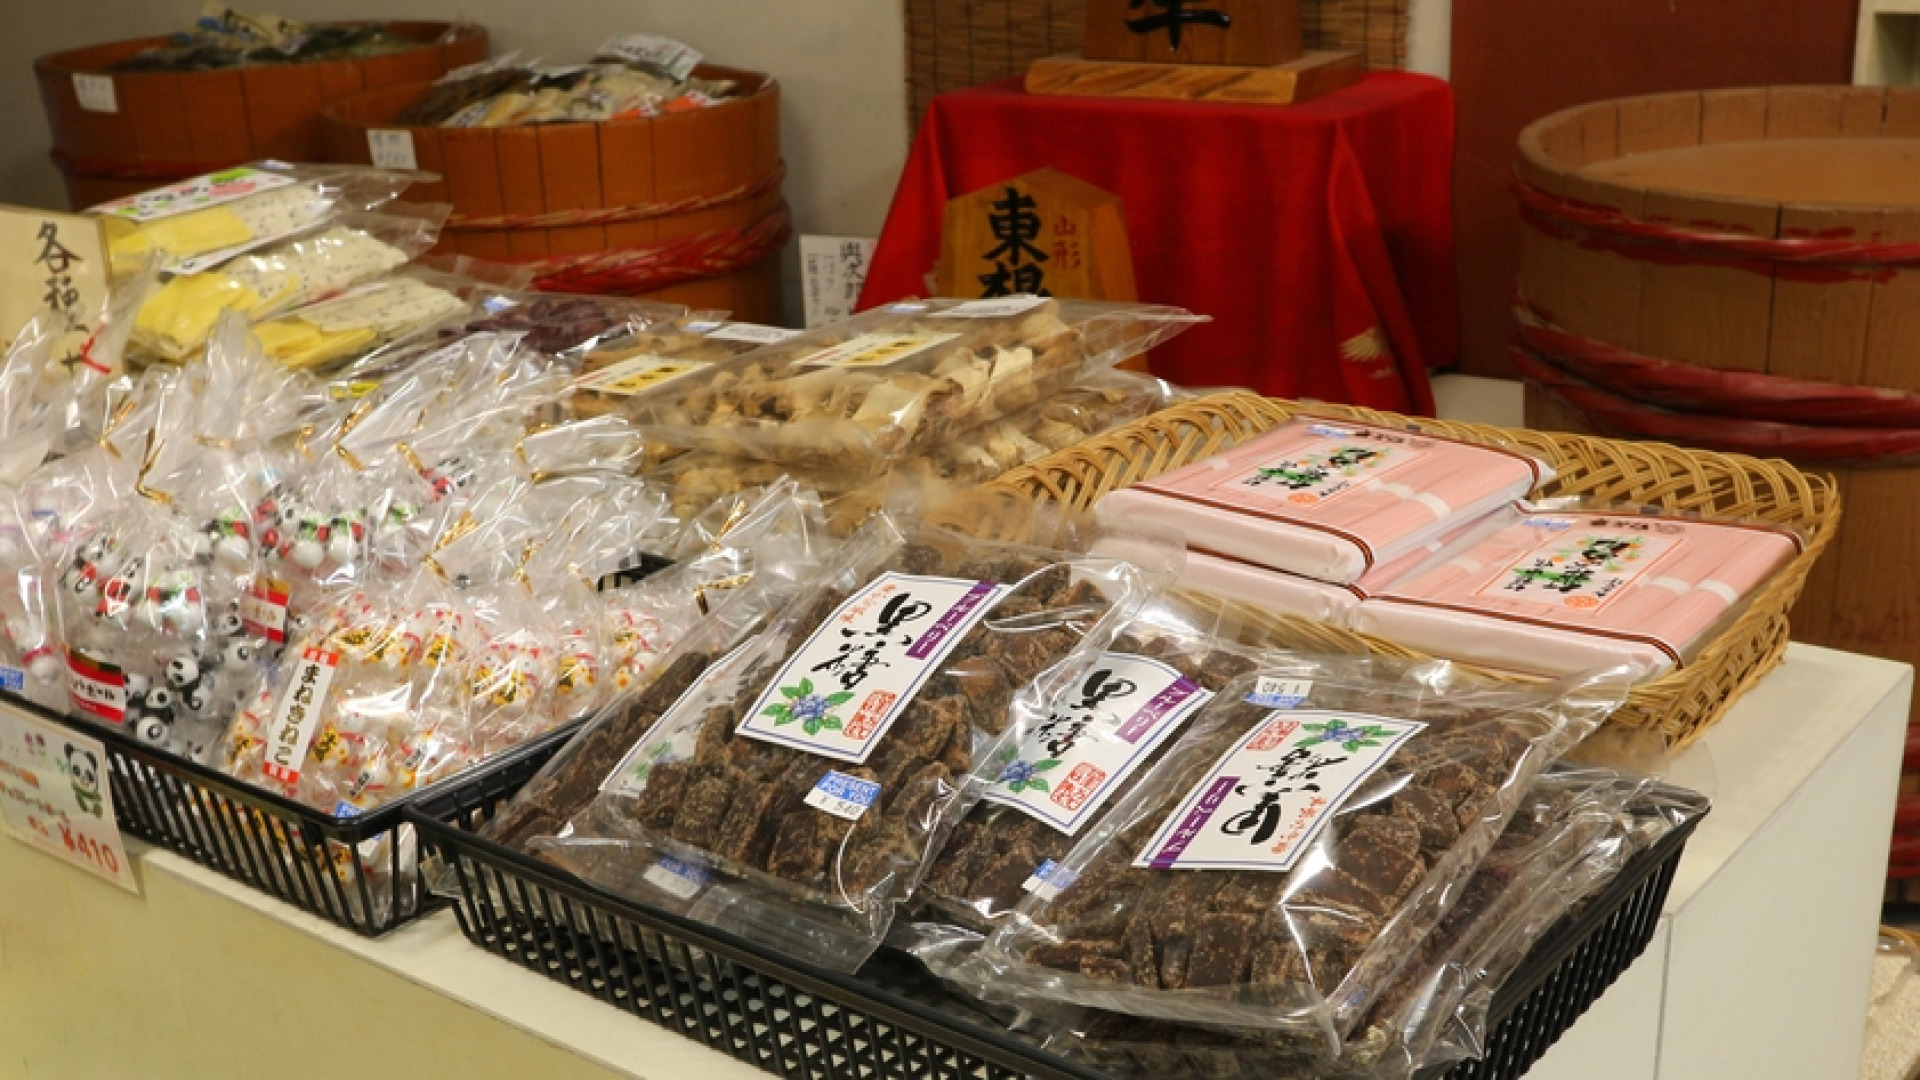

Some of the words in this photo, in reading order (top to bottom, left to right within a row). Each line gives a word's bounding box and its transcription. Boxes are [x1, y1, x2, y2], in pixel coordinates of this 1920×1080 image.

[1053, 216, 1081, 270] 山形
[273, 663, 320, 766] まねきねこ
[57, 821, 119, 874] ¥410
